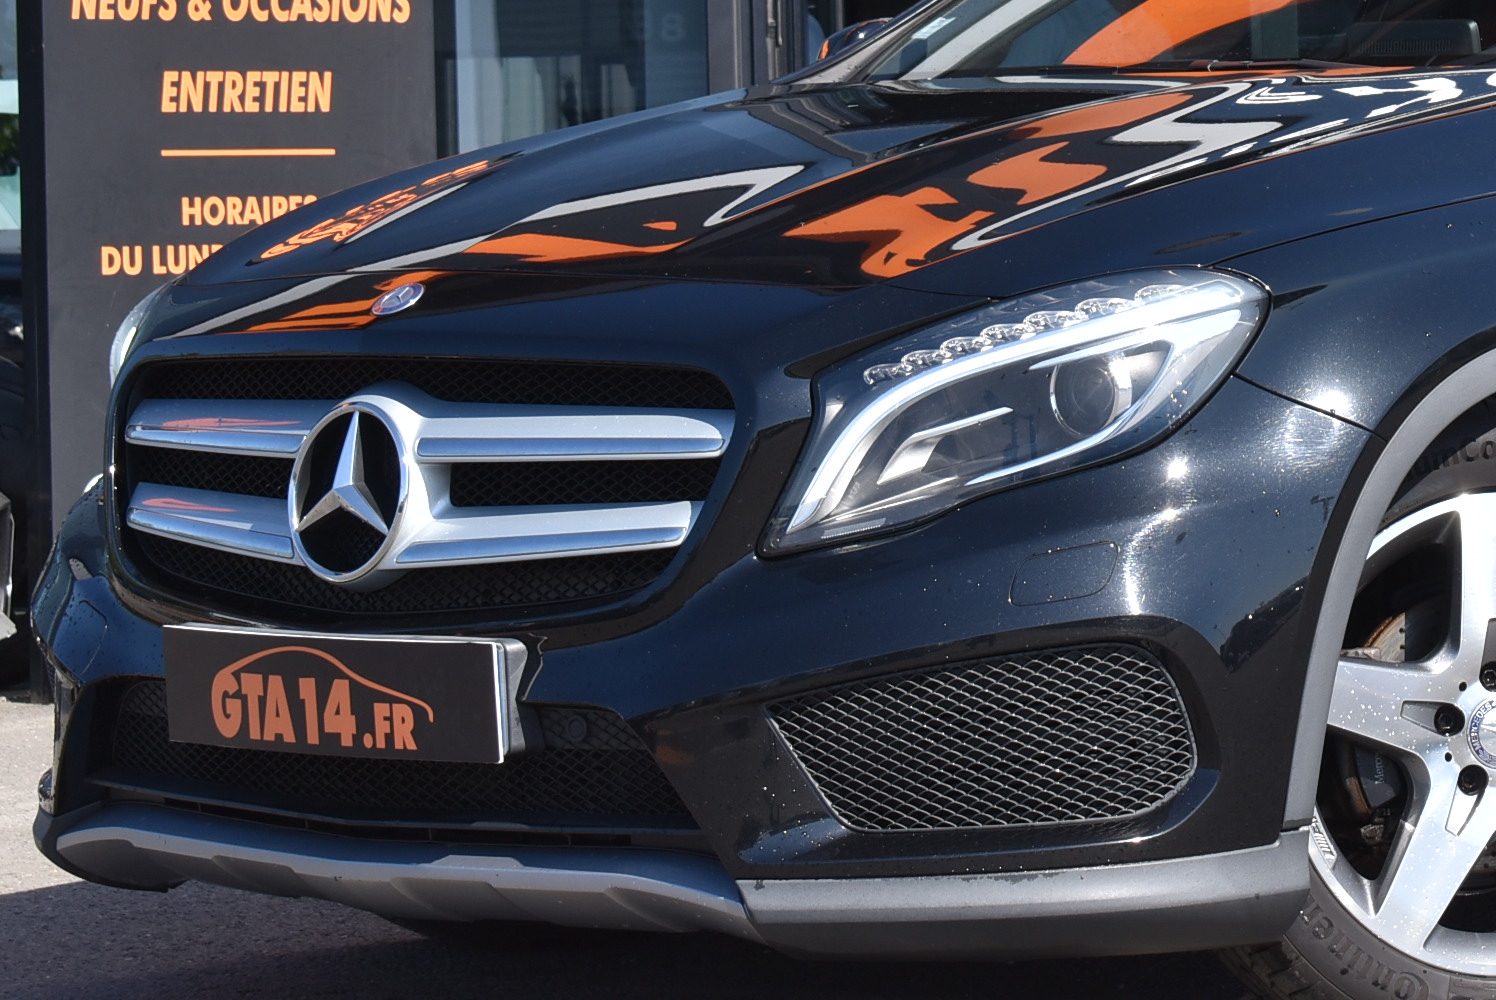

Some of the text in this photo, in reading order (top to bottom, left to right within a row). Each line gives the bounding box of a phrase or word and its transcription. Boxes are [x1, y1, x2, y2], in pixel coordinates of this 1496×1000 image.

[160, 70, 333, 114] ENTRETIEN
[100, 245, 143, 276] DU
[211, 669, 418, 751] GTA14.FR
